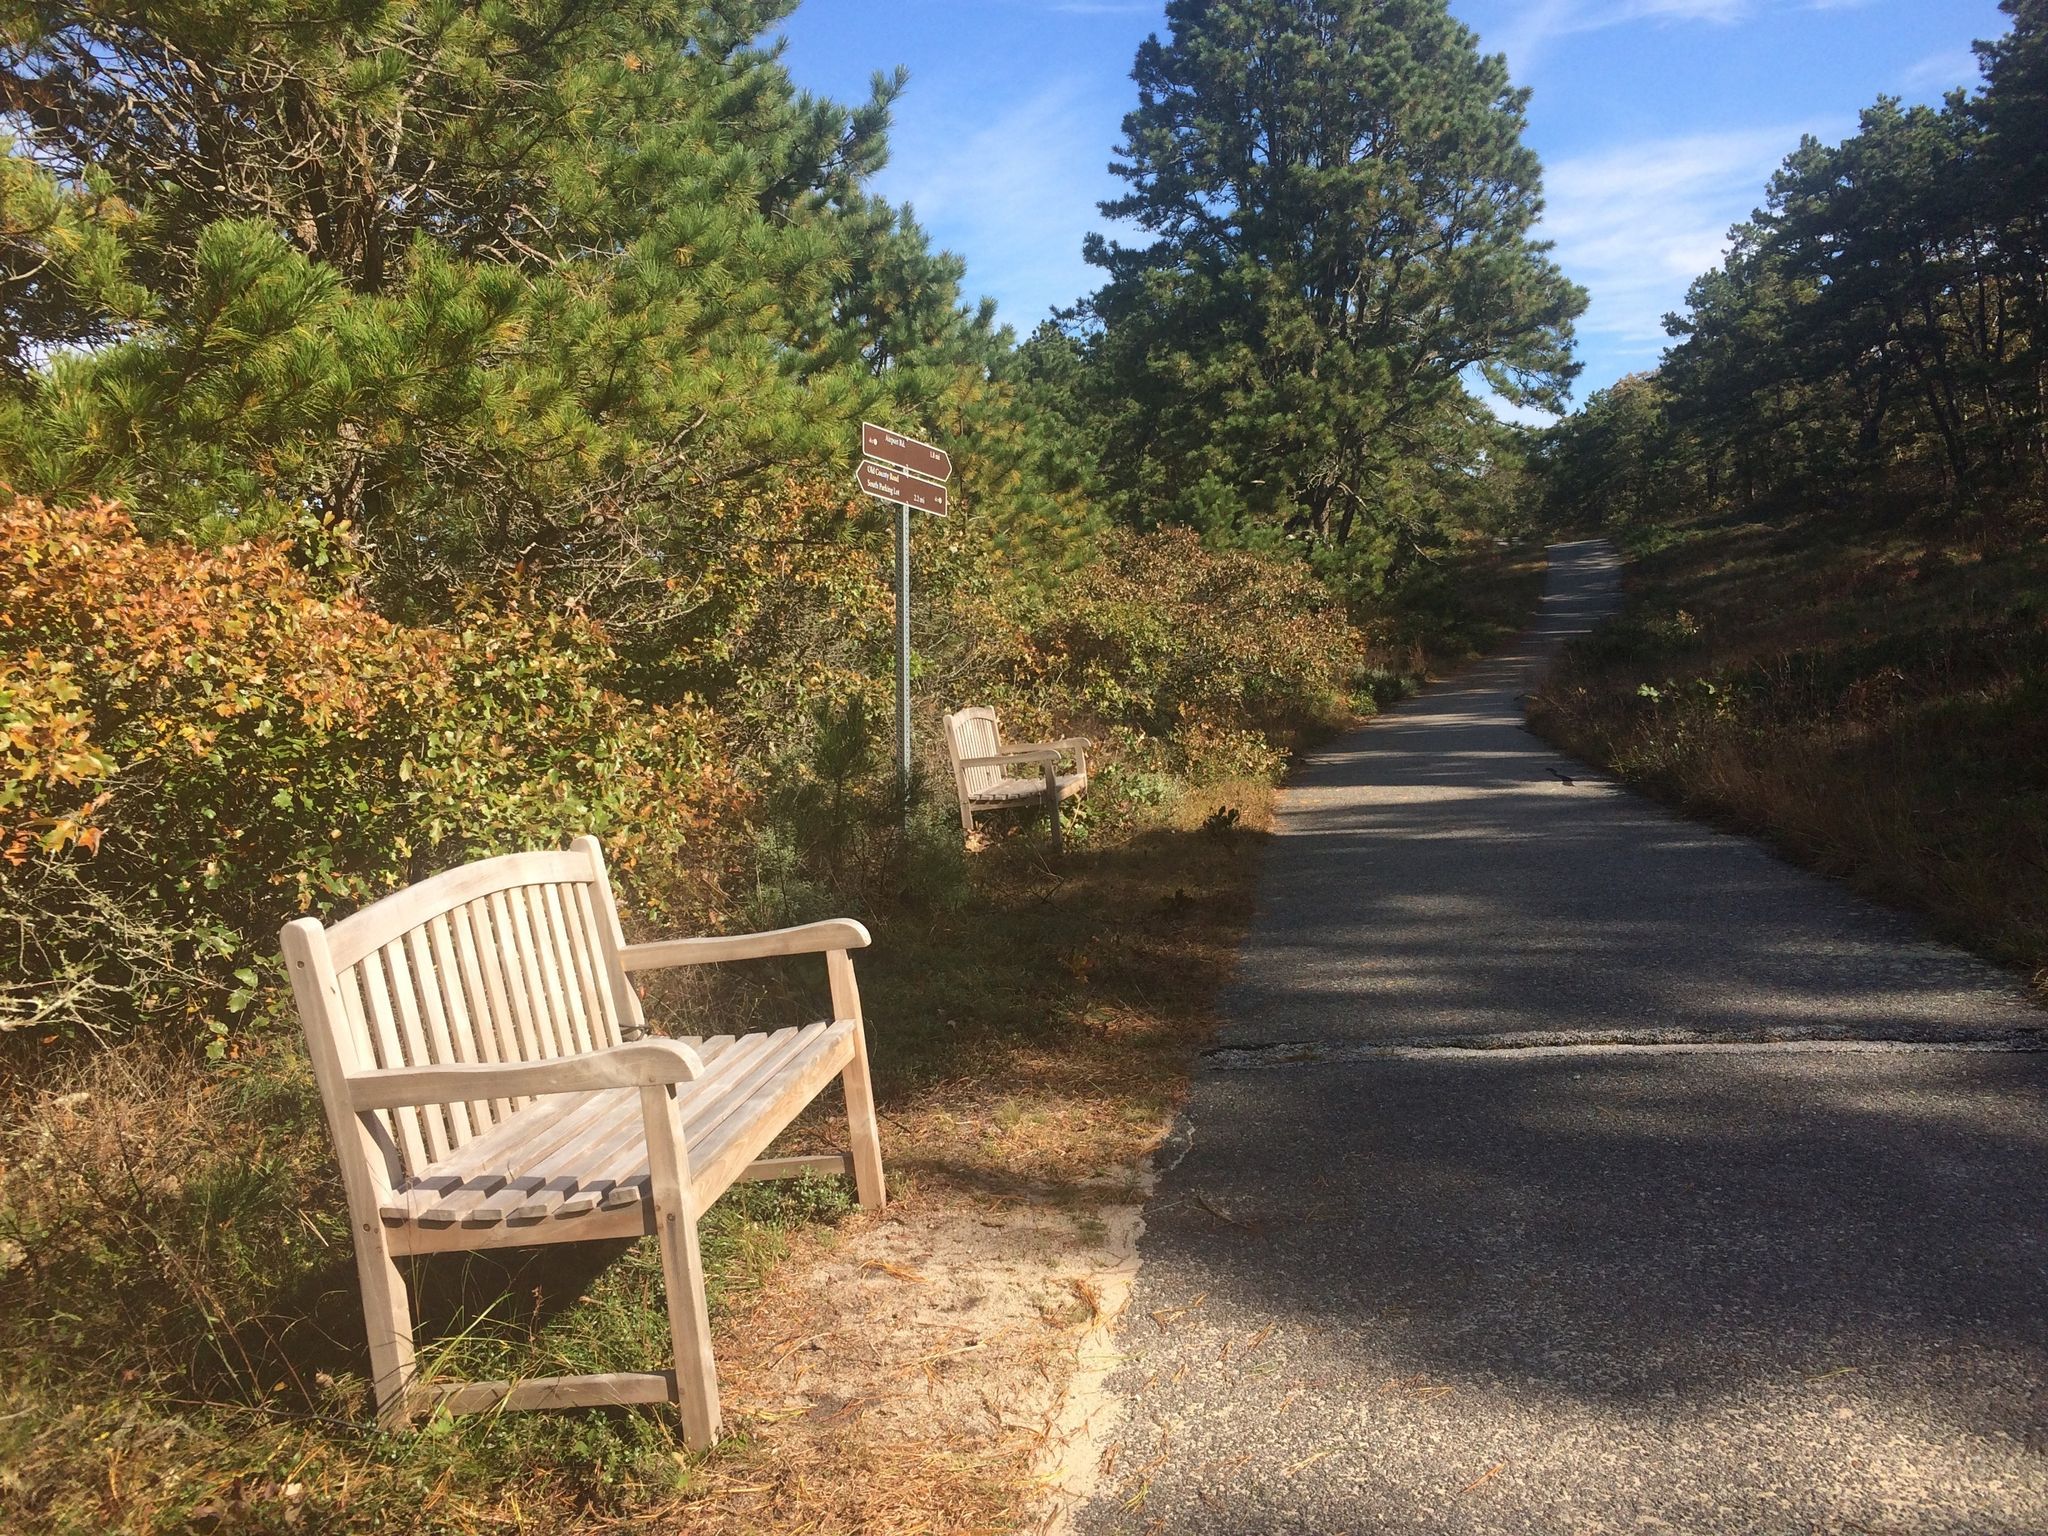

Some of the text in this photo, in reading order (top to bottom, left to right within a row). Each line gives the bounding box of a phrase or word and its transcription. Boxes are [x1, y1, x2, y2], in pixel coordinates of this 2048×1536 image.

[867, 465, 900, 483] Old County Road
[867, 479, 878, 489] South
[879, 482, 893, 496] Parking
